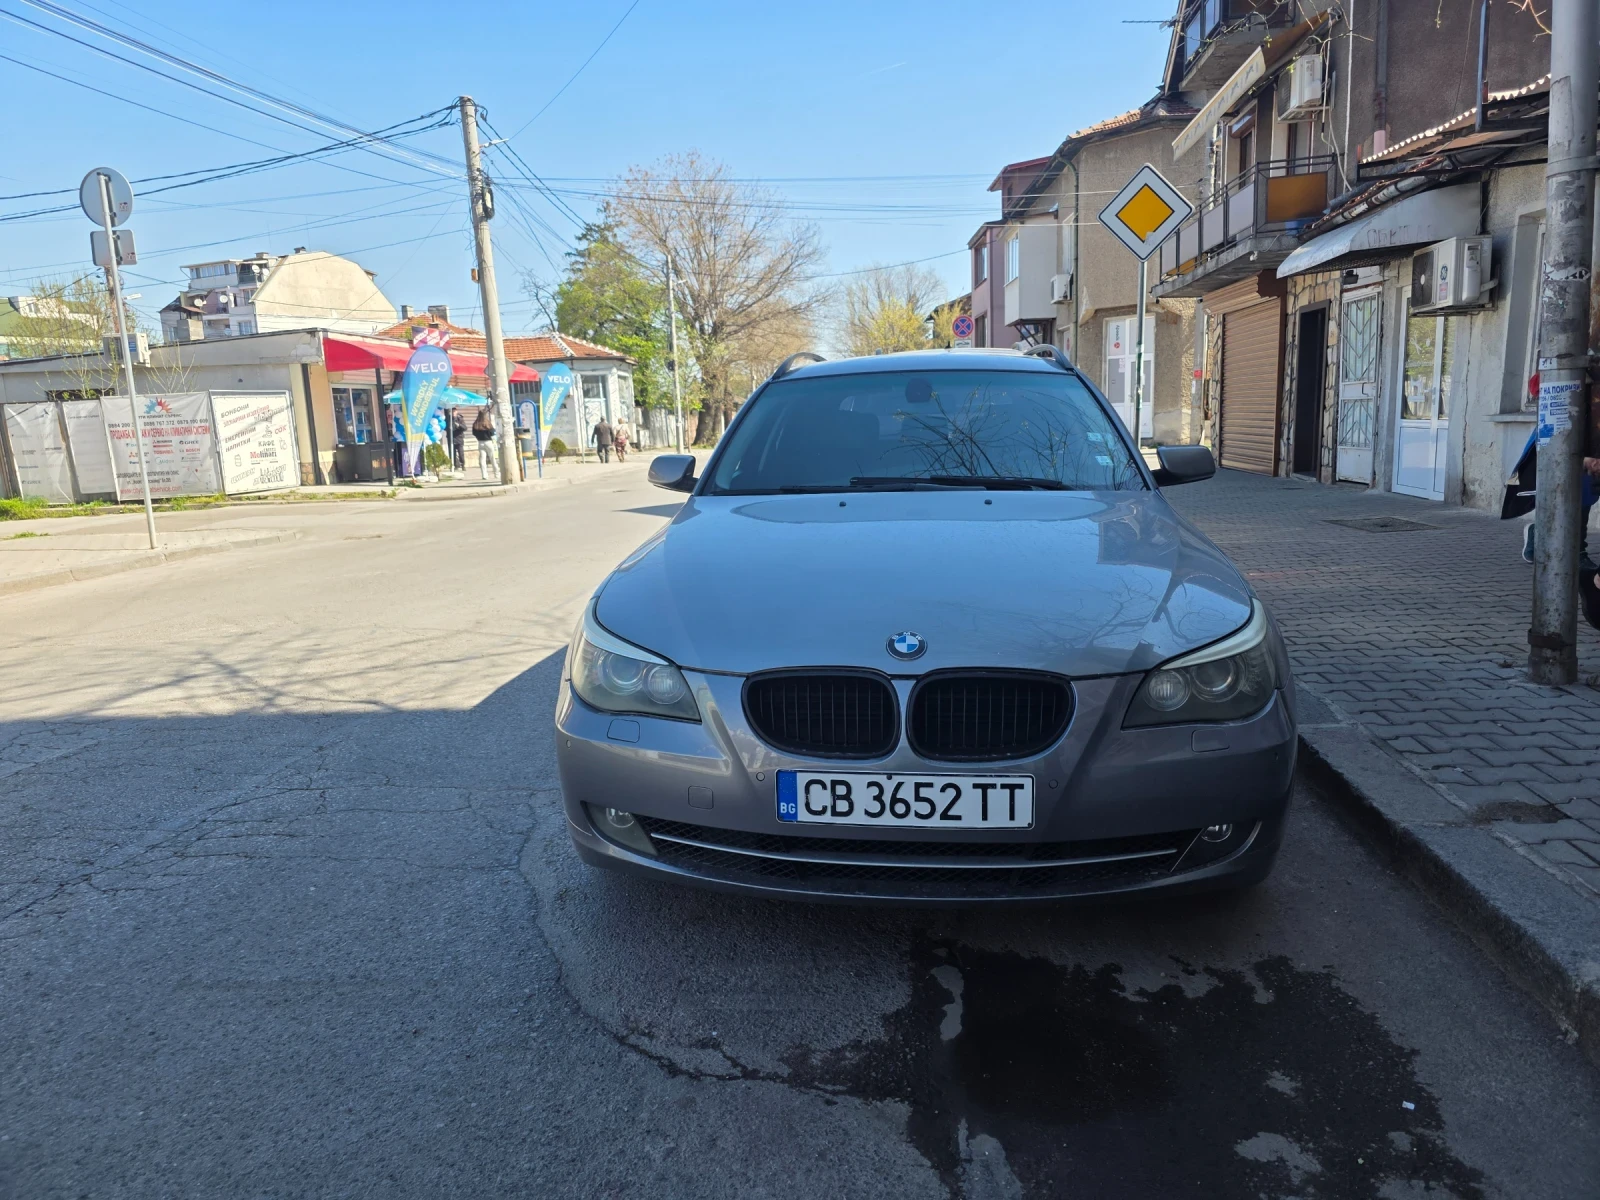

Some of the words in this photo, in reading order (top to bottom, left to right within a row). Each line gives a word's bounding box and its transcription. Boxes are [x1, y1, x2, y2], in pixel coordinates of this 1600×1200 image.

[411, 362, 448, 374] VELO
[548, 376, 570, 384] VELO
[410, 380, 428, 416] WEIRDLY
[414, 377, 440, 426] WONDERFUL
[220, 404, 249, 418] БОНБОНИ
[274, 425, 287, 434] СОК
[804, 779, 854, 817] CB
[864, 781, 962, 821] 3652
[972, 783, 1025, 822] TT
[780, 802, 796, 814] BG
